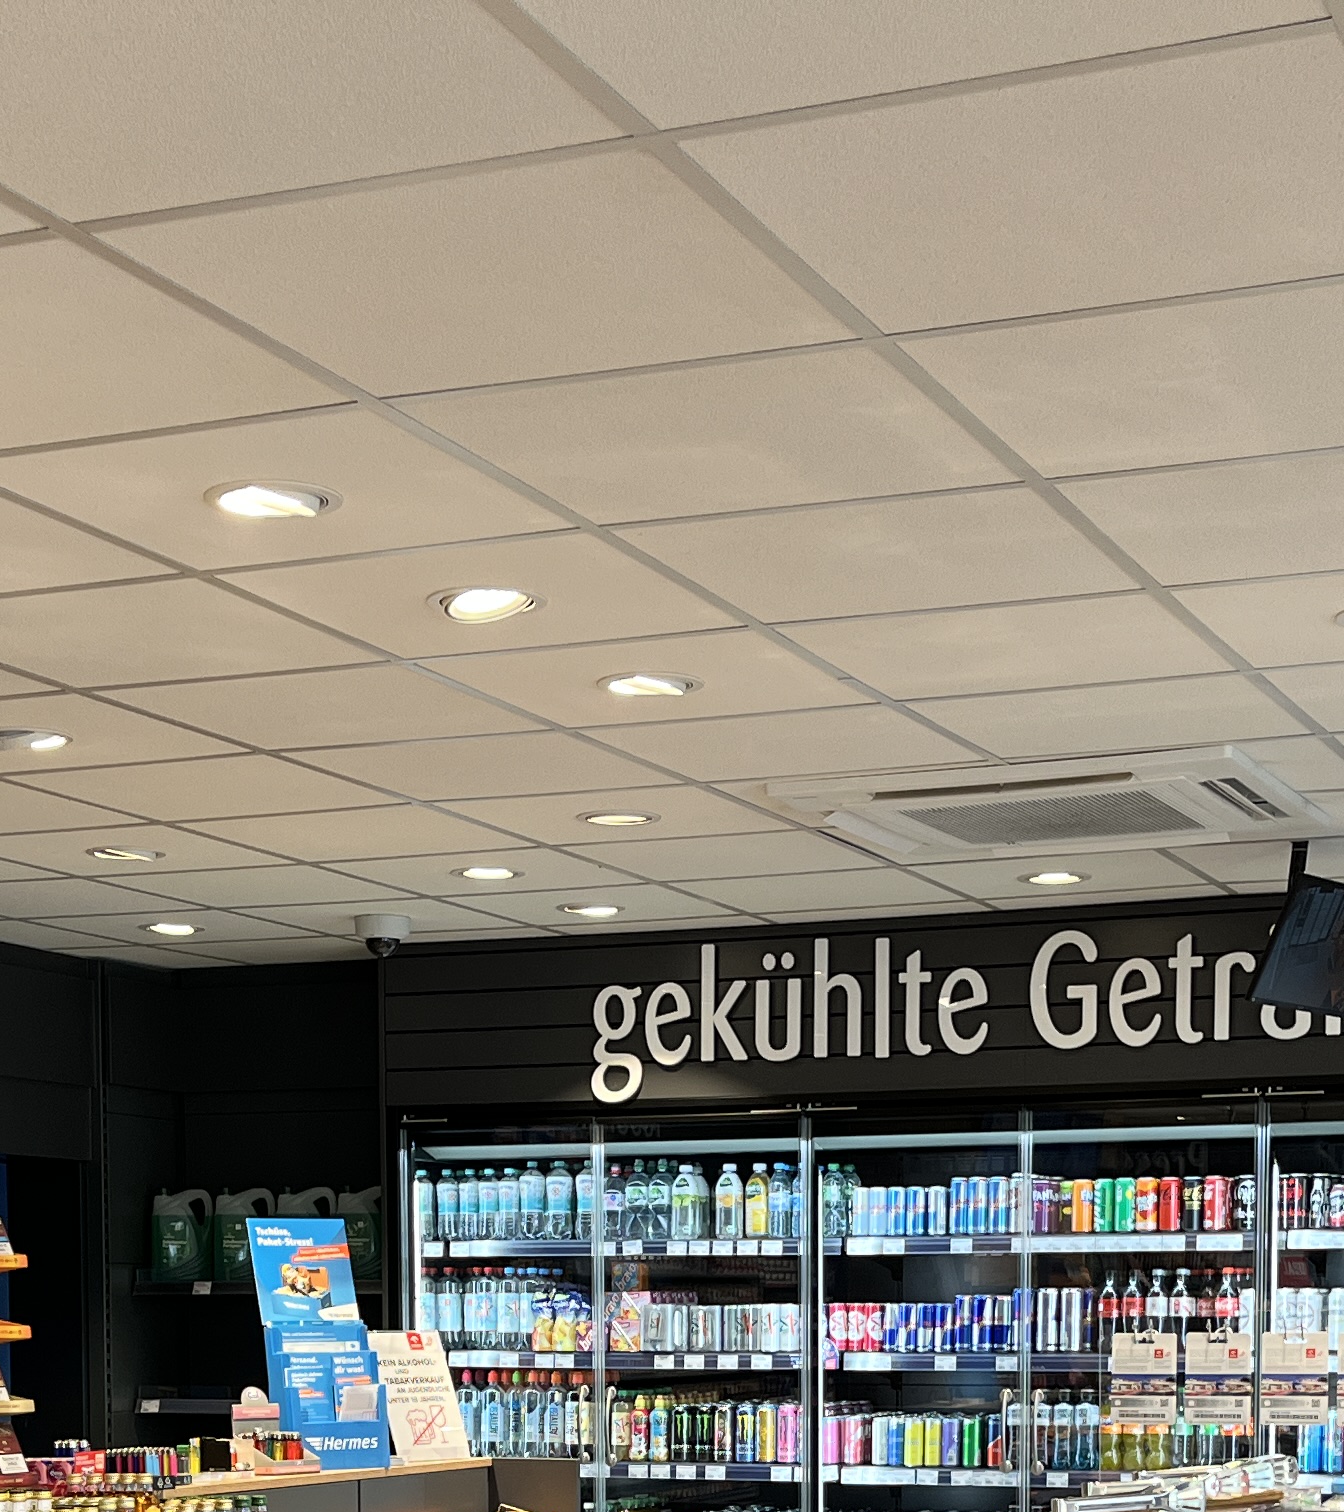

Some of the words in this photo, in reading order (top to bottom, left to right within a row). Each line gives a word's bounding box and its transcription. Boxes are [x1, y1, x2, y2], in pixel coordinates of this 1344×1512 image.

[590, 936, 989, 1105] gekühlte
[333, 1355, 364, 1364] Wünsch
[384, 1376, 445, 1384] TABAKVERKAUF
[323, 1435, 378, 1451] Hermes
